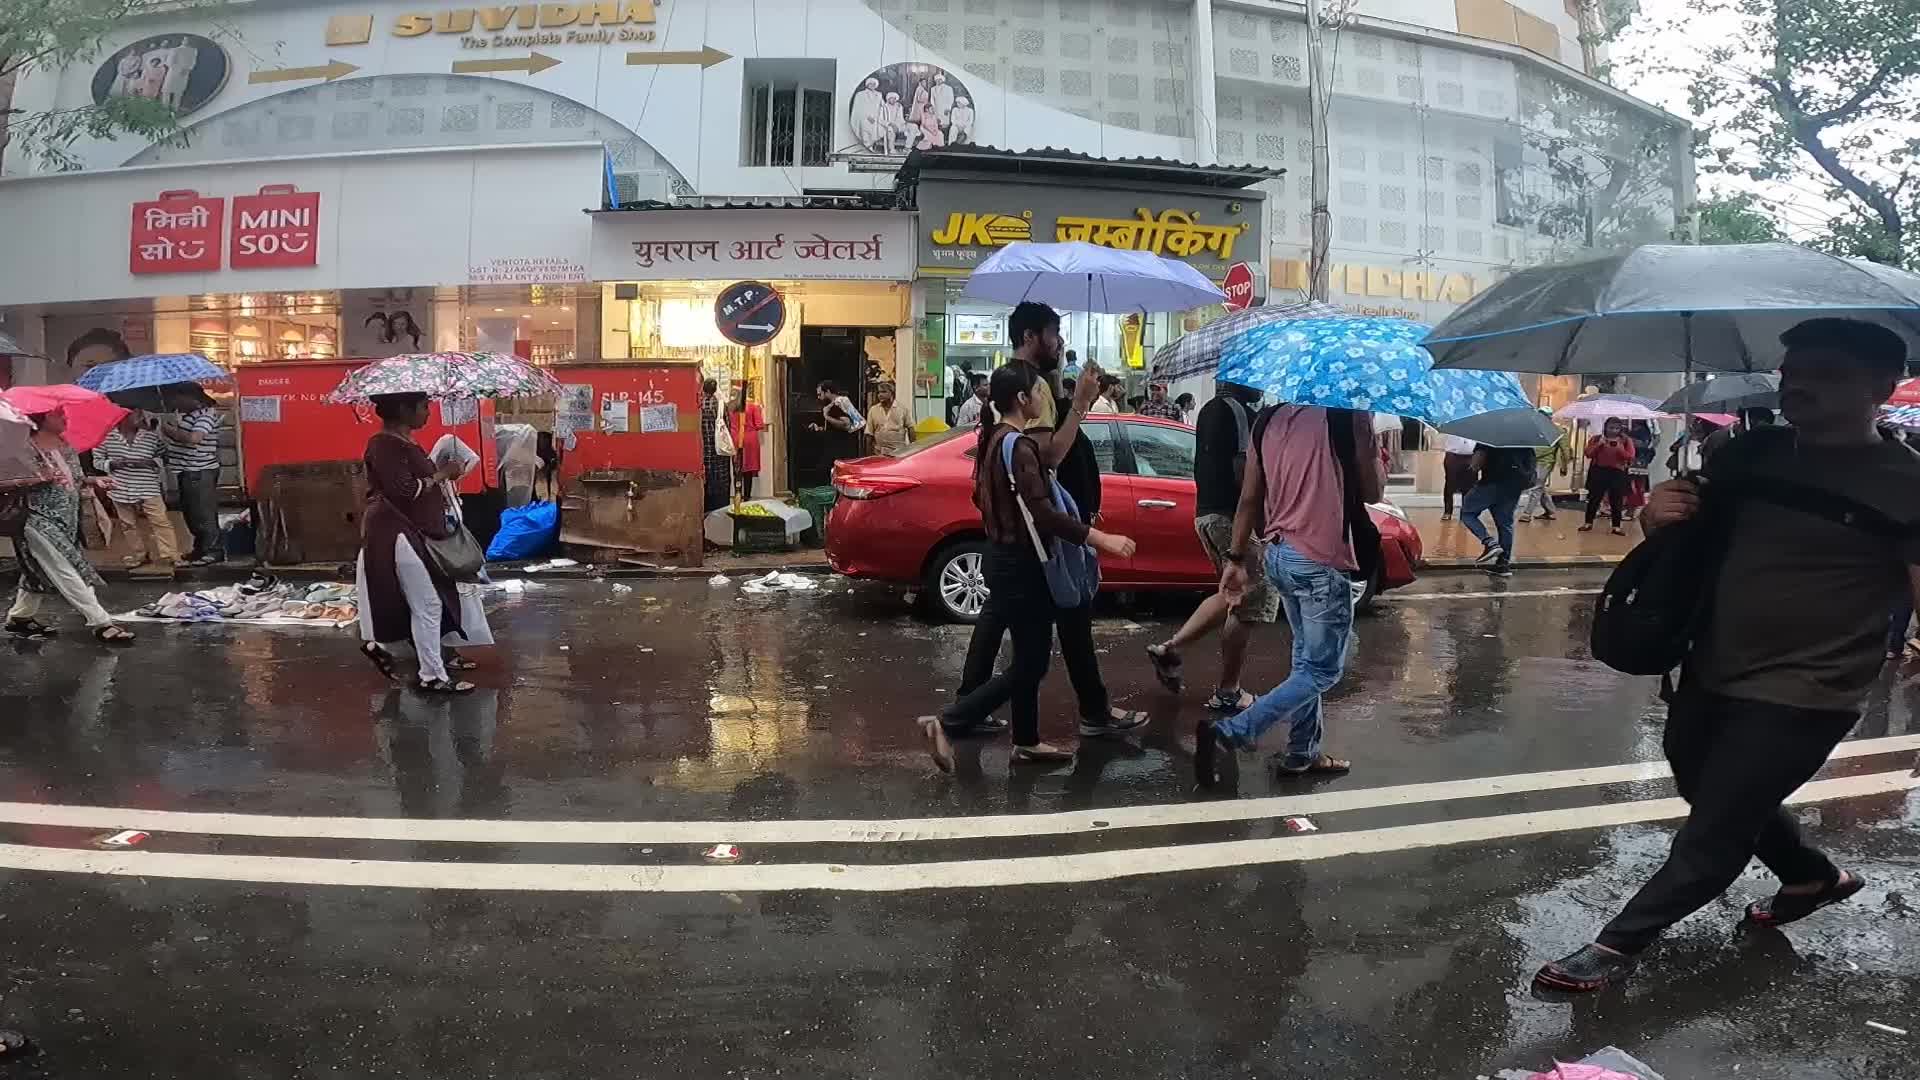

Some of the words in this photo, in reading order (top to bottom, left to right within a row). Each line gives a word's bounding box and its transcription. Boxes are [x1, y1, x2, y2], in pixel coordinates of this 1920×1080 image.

[391, 0, 657, 37] SUVIDHA
[460, 35, 488, 49] The
[492, 33, 562, 48] Complete
[566, 31, 615, 46] Family
[618, 29, 656, 44] Shop
[144, 205, 210, 231] मिनी
[239, 207, 310, 229] MINI
[932, 212, 998, 246] JK
[138, 236, 175, 261] सो
[631, 240, 720, 268] युवराज
[728, 233, 786, 260] आर्ट
[792, 233, 884, 261] ज्वेलर्स
[722, 290, 760, 316] M.T.P.
[1224, 281, 1251, 300] STOP
